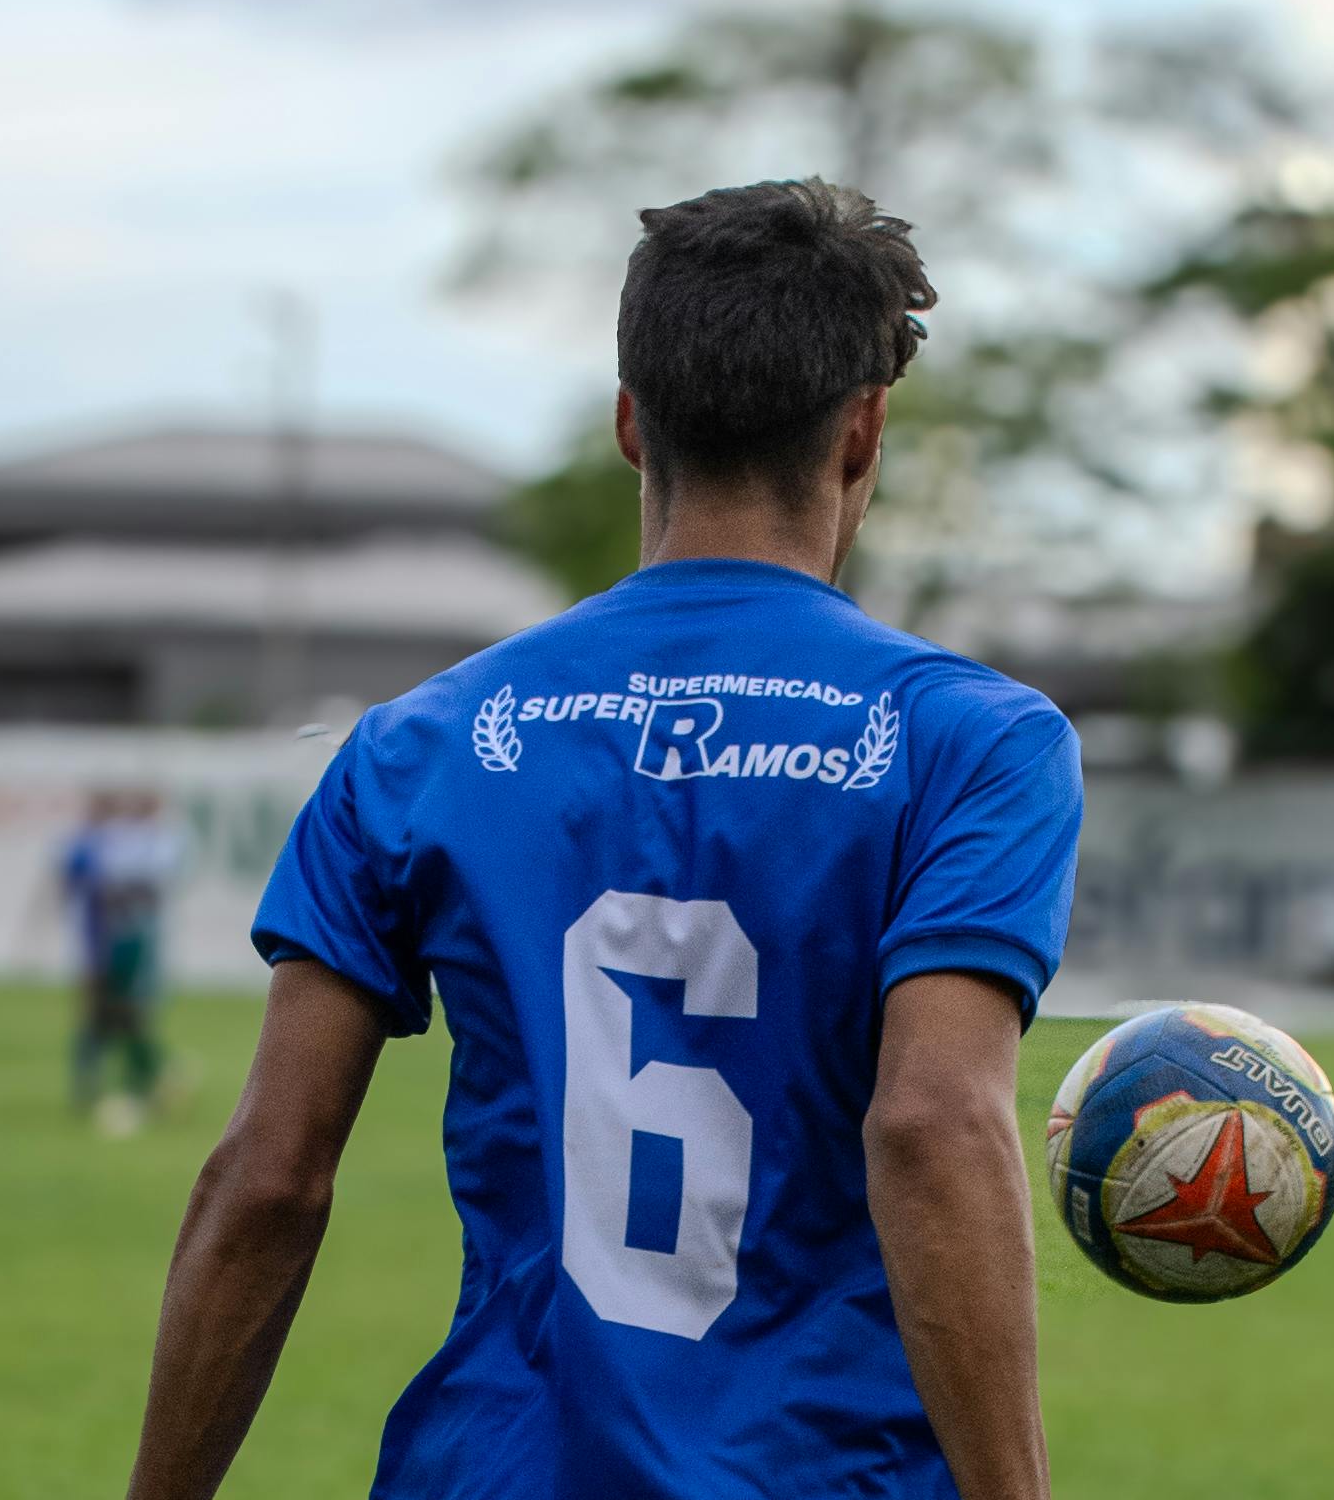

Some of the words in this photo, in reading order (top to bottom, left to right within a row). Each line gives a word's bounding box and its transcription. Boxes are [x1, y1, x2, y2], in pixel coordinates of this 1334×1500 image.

[628, 672, 863, 707] SUPERMERCADO
[518, 693, 647, 725] SUPER
[634, 699, 850, 785] RAMOS
[562, 888, 759, 1342] 6
